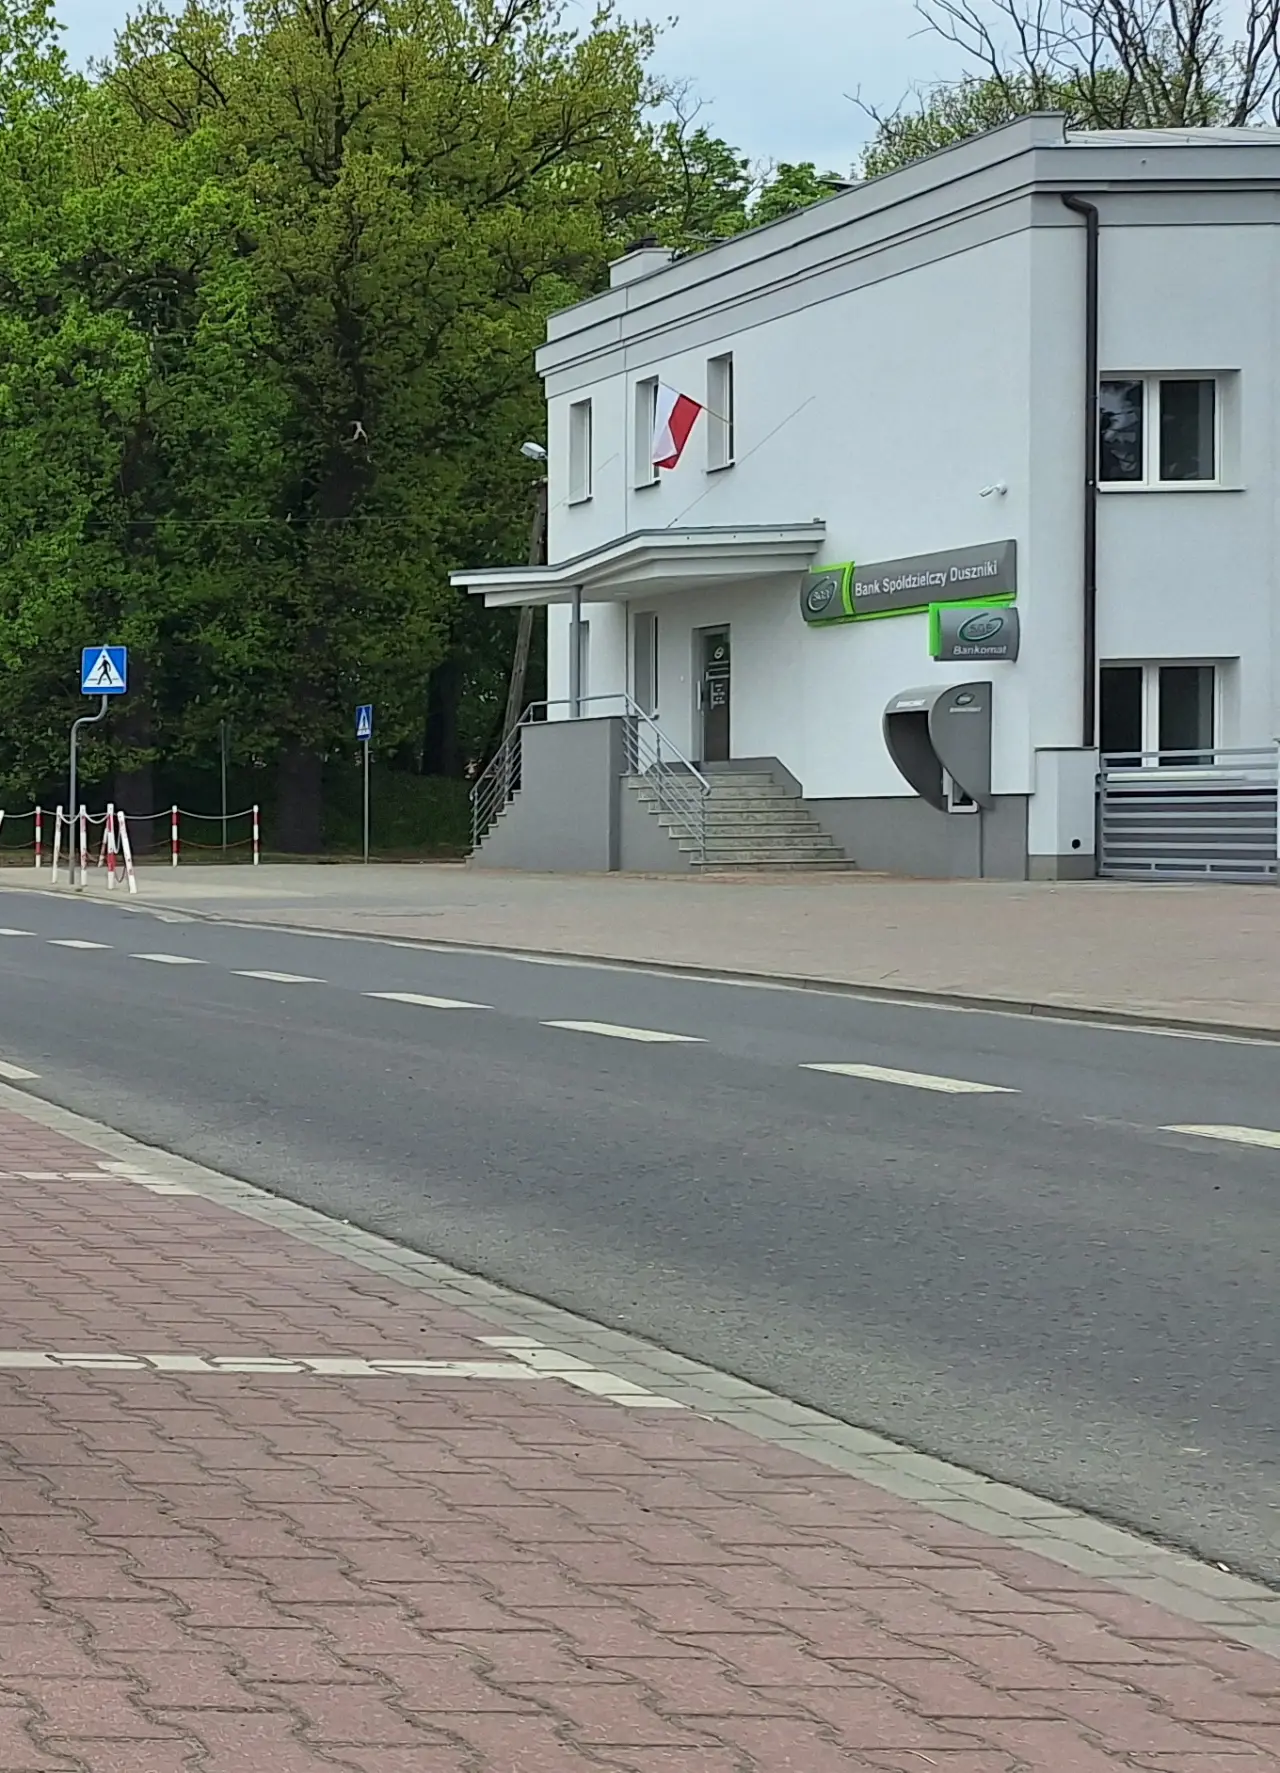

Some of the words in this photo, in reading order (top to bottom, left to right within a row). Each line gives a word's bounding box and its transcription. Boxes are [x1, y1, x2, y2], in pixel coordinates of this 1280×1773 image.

[855, 580, 881, 596] Bank
[949, 560, 998, 581] Duszniki
[953, 645, 1007, 655] Bankomat
